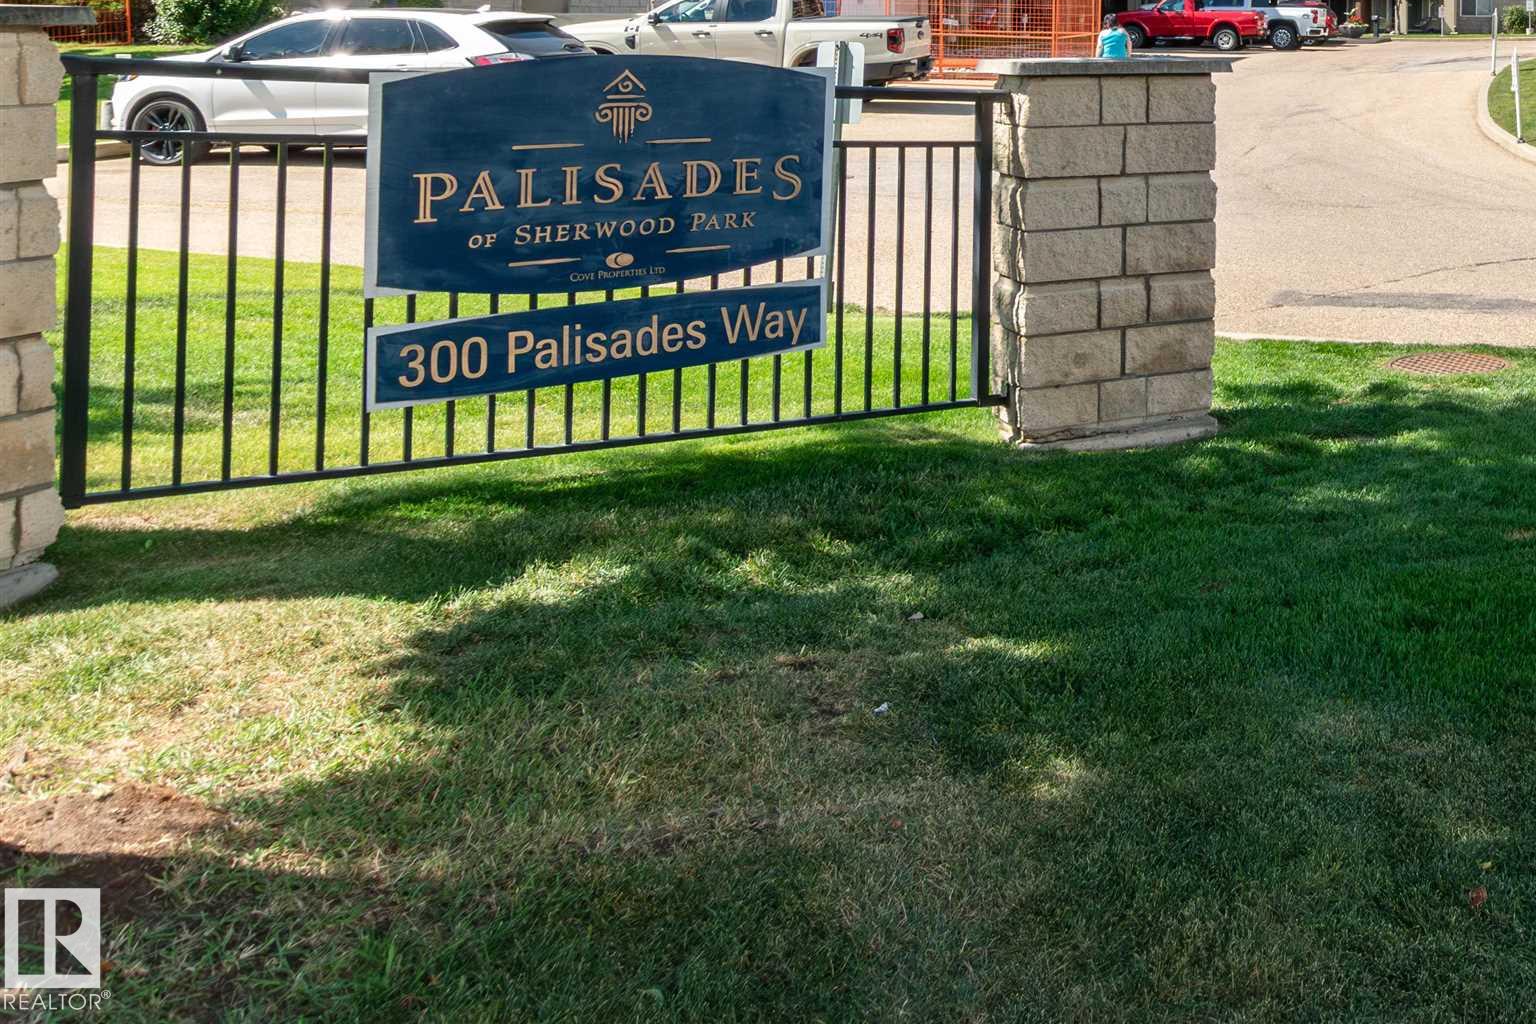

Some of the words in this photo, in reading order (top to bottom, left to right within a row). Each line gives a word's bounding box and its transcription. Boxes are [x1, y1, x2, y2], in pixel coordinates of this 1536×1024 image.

[412, 154, 802, 224] PALISADES
[514, 216, 676, 245] SHERWOOD
[690, 211, 758, 232] PARK
[398, 336, 489, 388] 300
[507, 314, 707, 374] Palisades
[720, 302, 808, 345] Way
